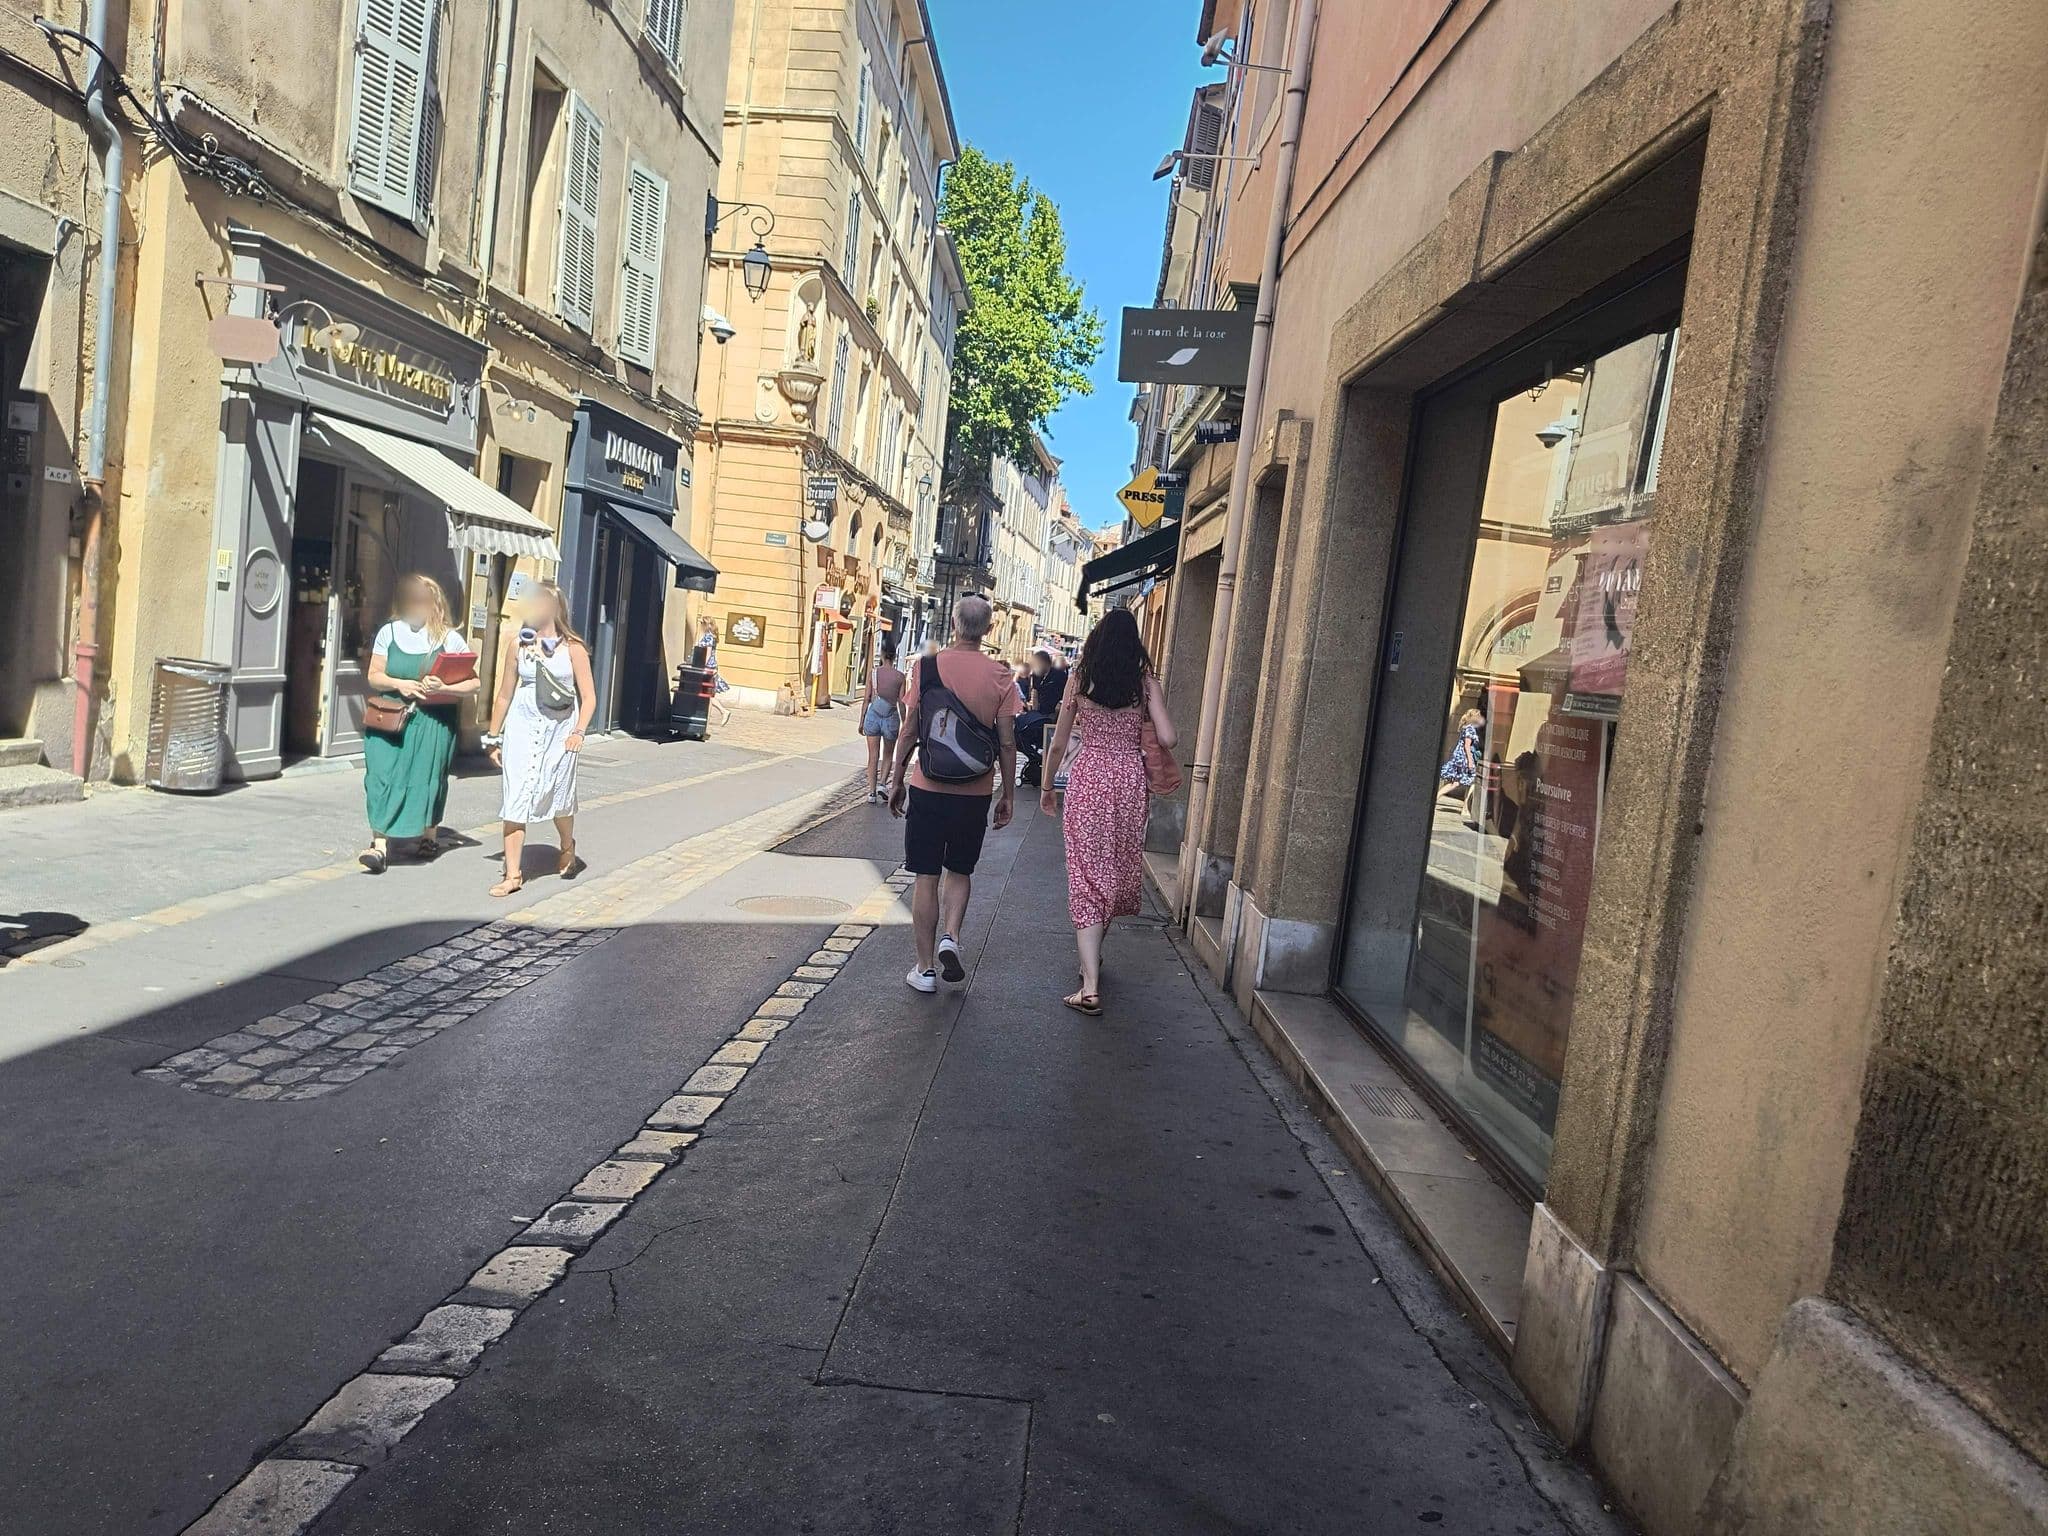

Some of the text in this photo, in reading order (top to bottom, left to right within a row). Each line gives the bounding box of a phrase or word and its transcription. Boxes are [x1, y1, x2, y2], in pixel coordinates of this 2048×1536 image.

[1131, 325, 1227, 340] au nom de la rose
[1124, 489, 1165, 504] PRESS
[1536, 777, 1572, 802] Poursuivre
